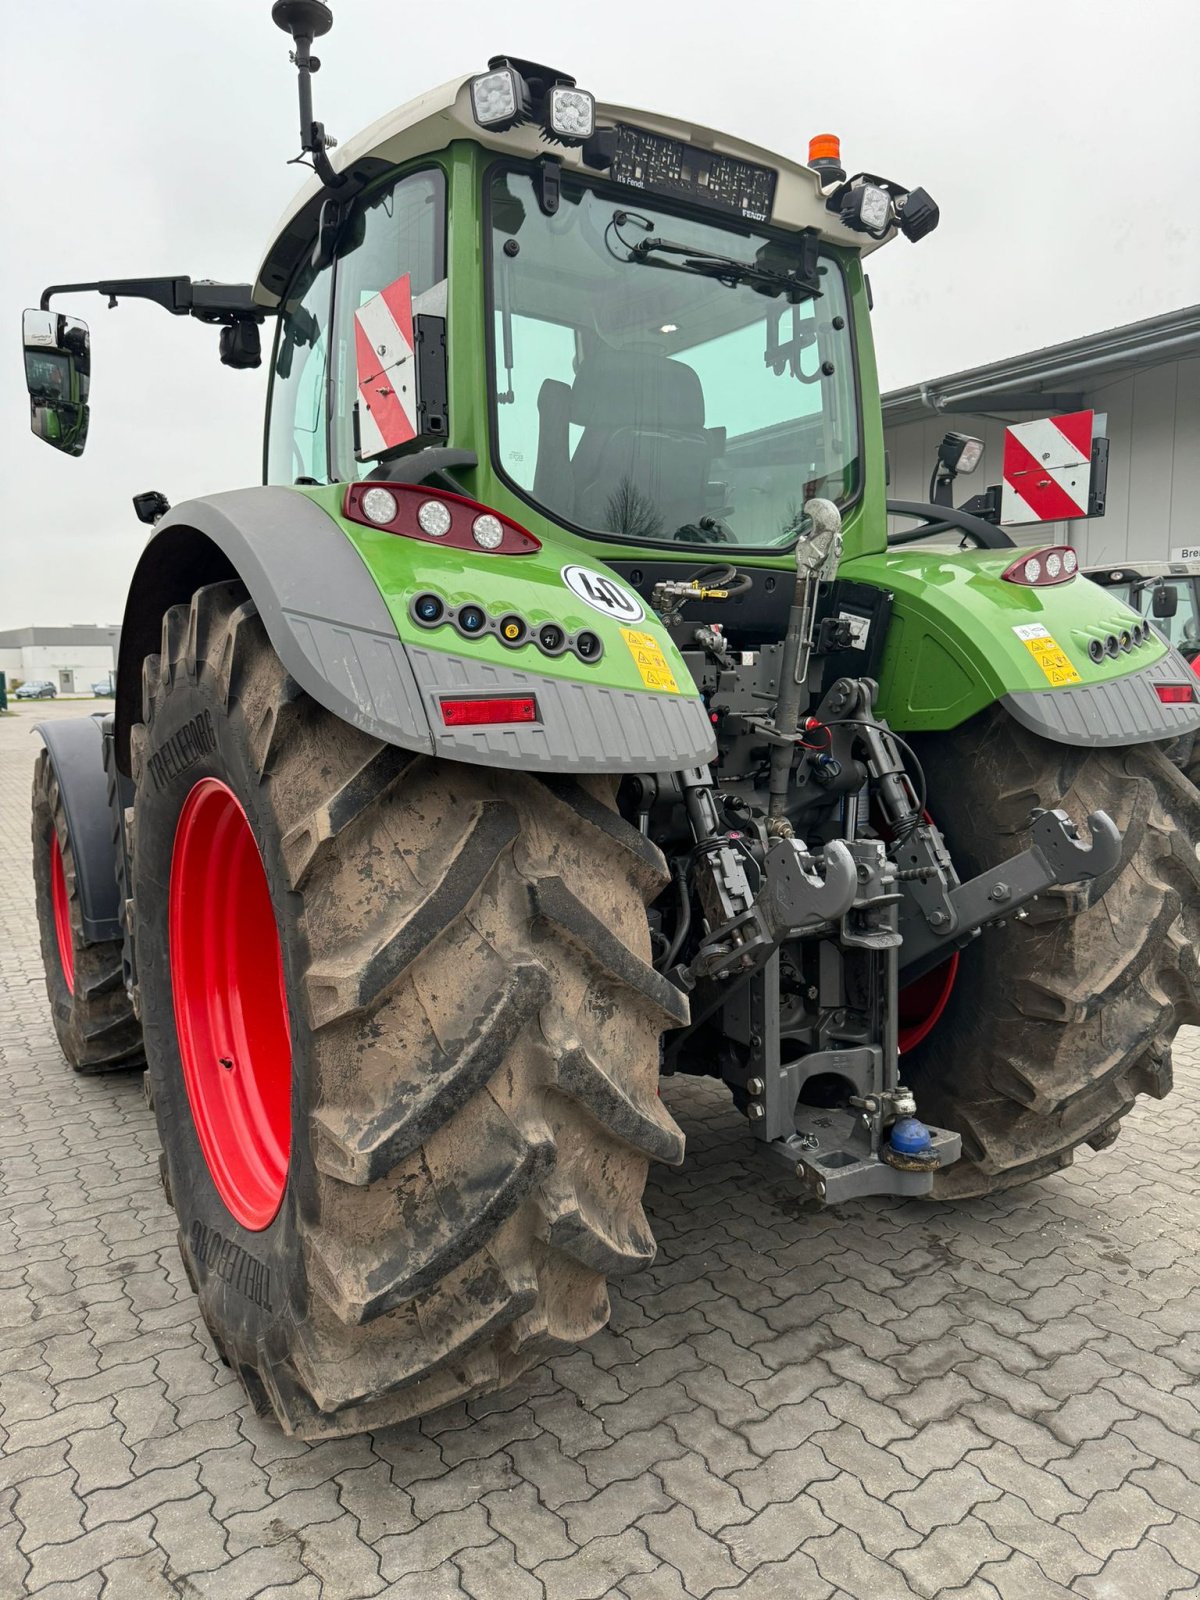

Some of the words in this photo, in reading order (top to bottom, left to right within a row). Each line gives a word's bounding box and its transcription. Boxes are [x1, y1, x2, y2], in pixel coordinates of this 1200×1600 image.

[617, 174, 625, 184] It's
[742, 209, 766, 221] FENDT
[1181, 549, 1200, 558] Bre
[578, 572, 635, 612] 40
[147, 708, 217, 790] TRELLEBORG
[190, 1219, 273, 1313] TRELLEBORG
